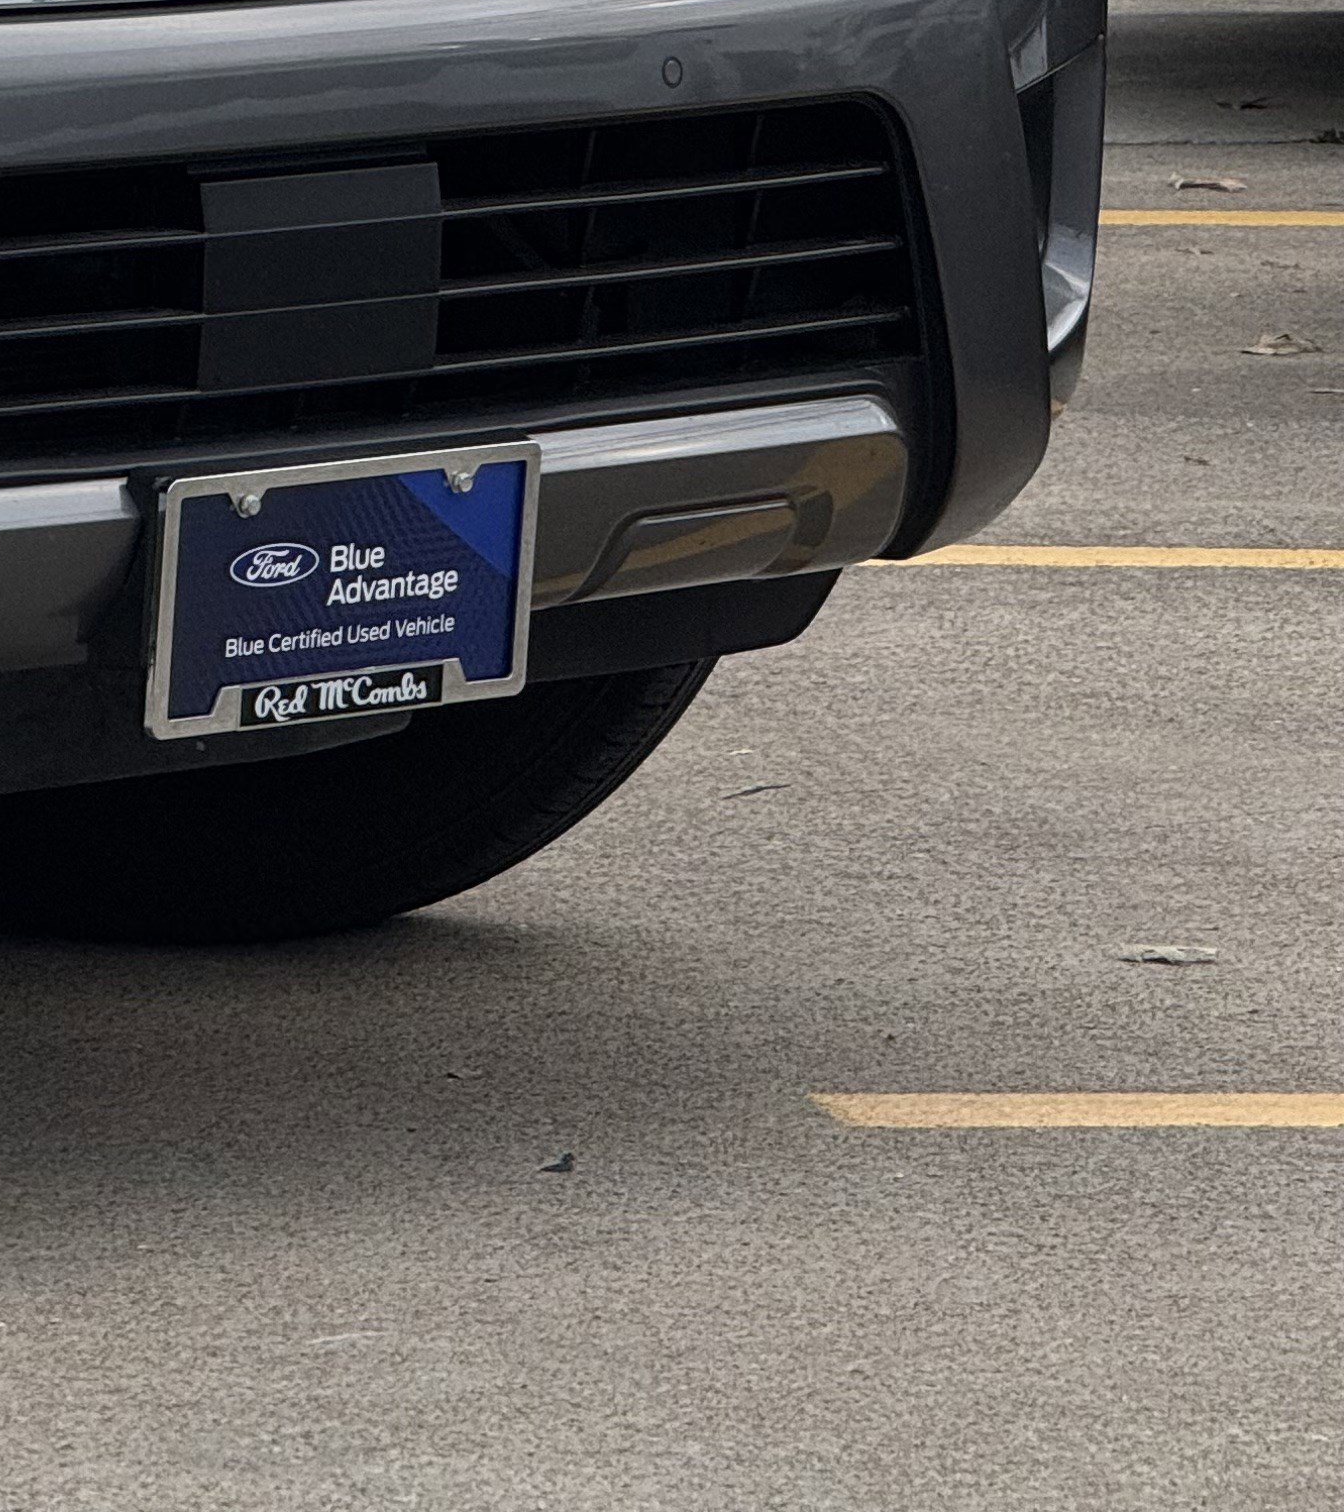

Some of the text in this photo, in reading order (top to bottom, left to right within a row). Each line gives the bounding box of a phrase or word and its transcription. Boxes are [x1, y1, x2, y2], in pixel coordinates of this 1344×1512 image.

[245, 548, 303, 581] Ford
[329, 542, 386, 573] Blue
[325, 569, 459, 607] Advantage
[224, 614, 456, 658] Blue Certified Used Vehicle
[254, 672, 428, 722] Red McCombs
